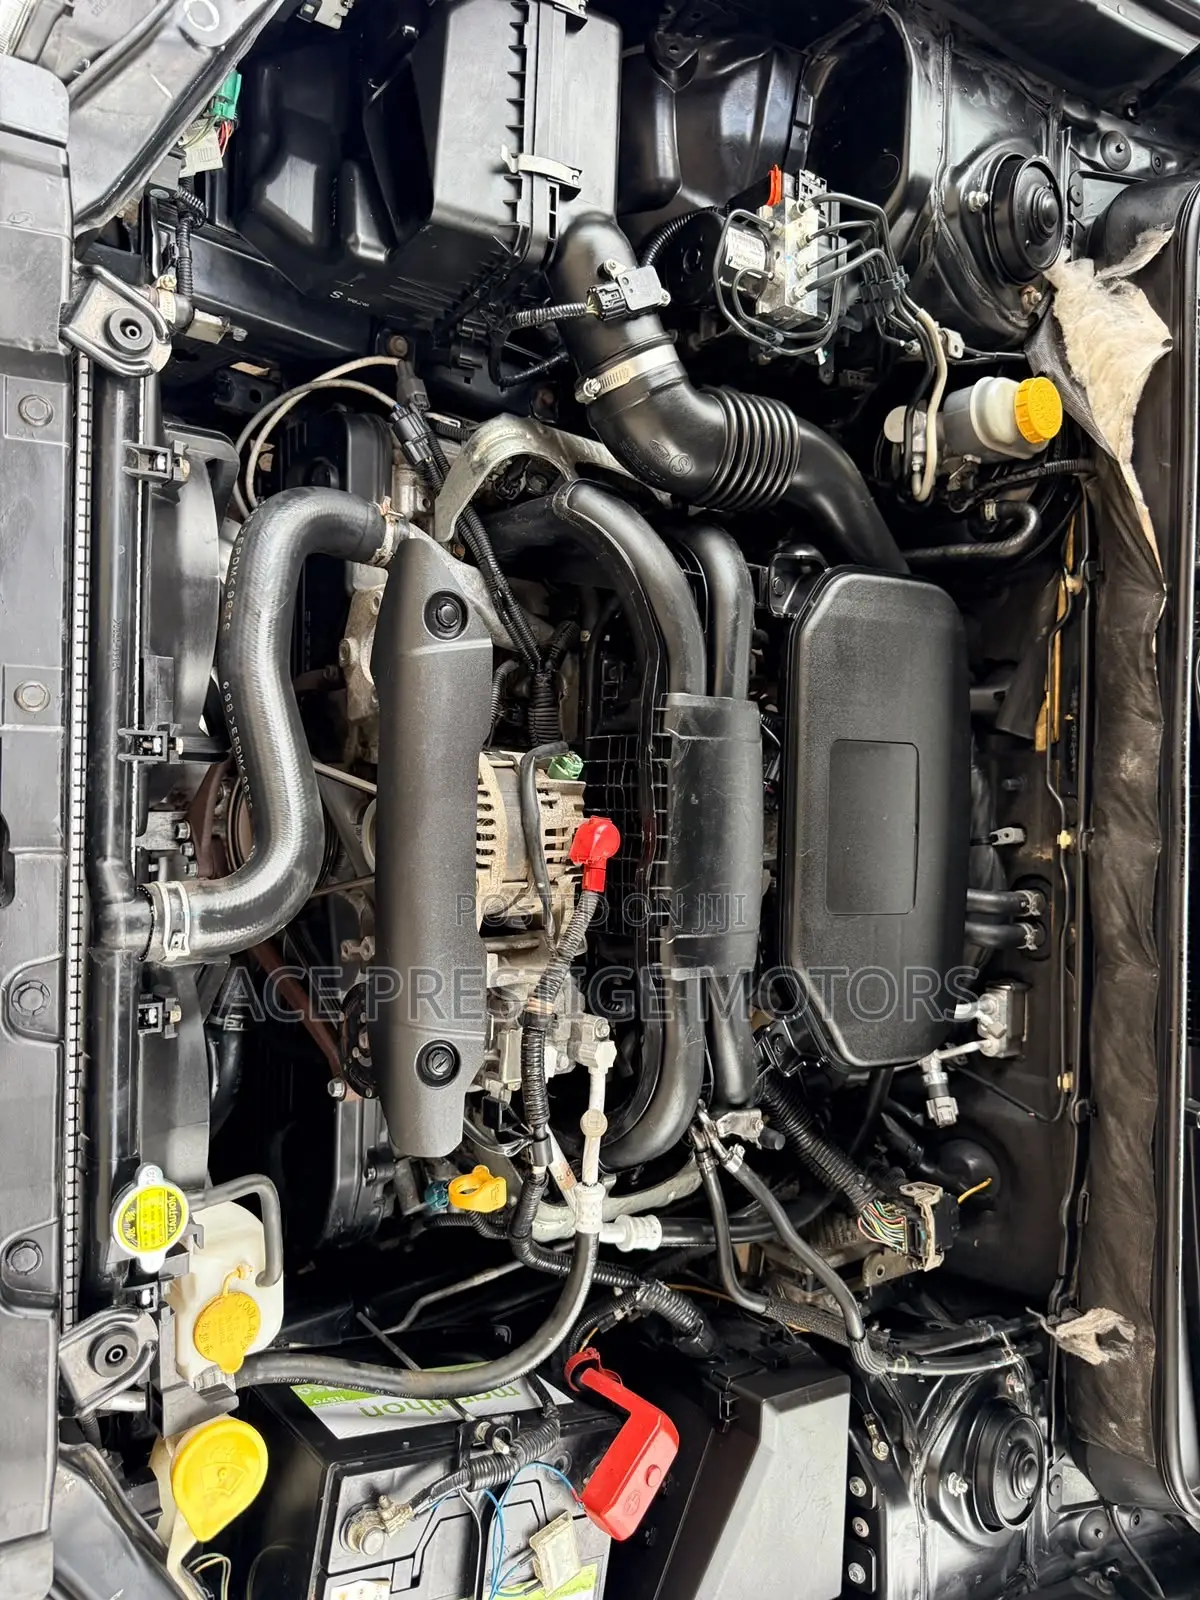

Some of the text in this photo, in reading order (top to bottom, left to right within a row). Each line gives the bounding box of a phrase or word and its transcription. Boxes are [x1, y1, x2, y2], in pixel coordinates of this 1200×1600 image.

[167, 1195, 179, 1233] CAUTION
[312, 1395, 346, 1405] NS70
[360, 1386, 520, 1418] marthon
